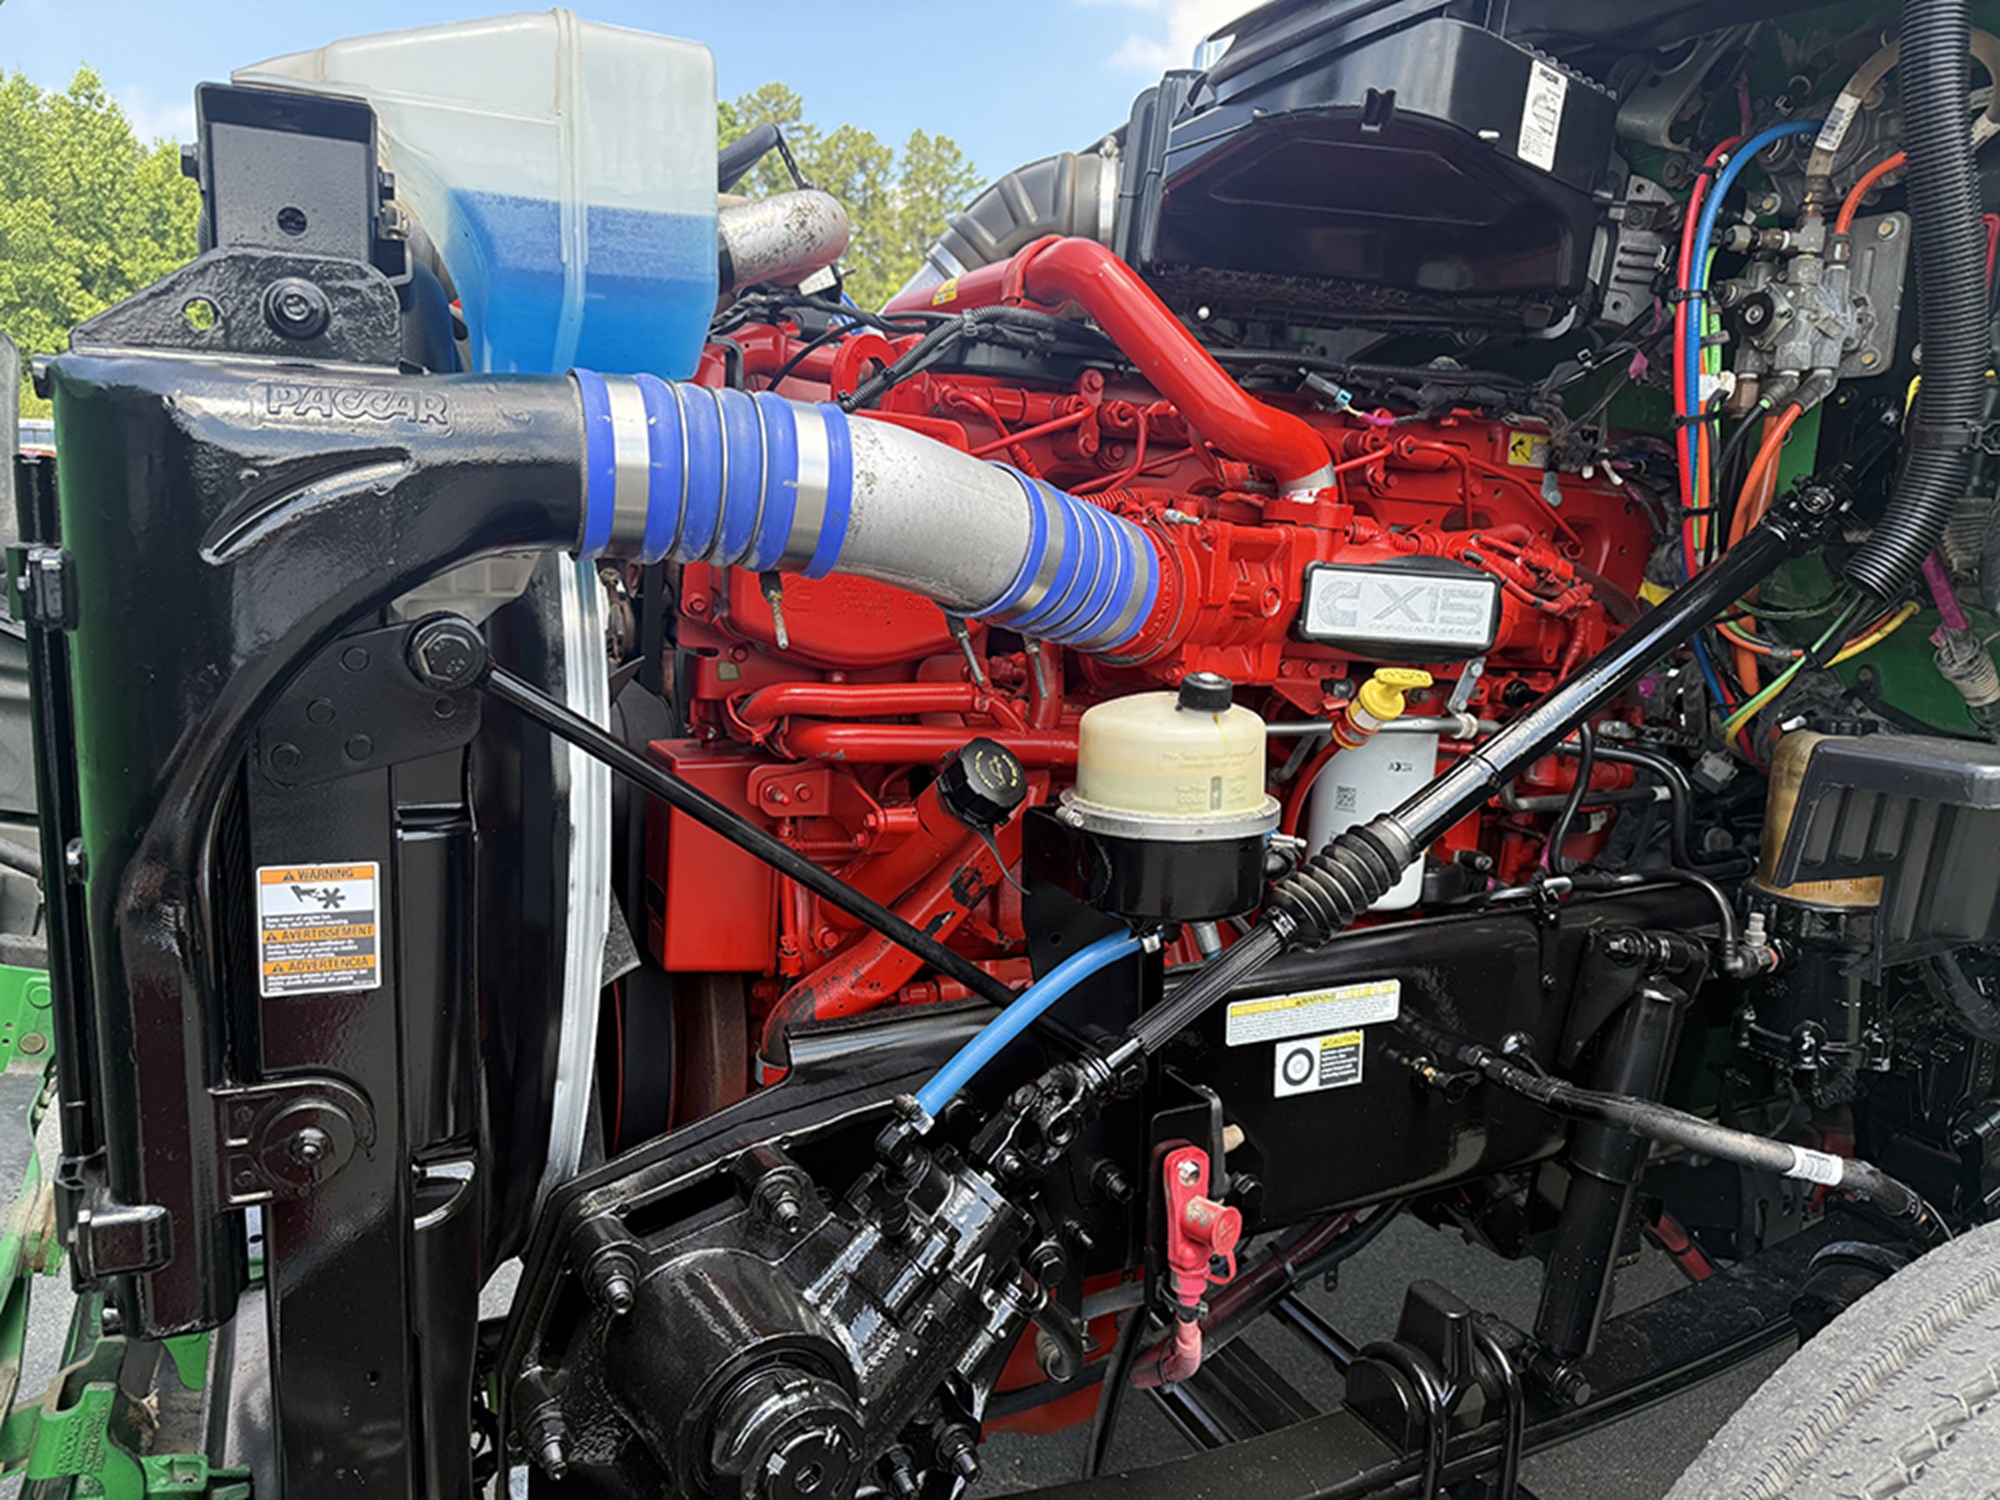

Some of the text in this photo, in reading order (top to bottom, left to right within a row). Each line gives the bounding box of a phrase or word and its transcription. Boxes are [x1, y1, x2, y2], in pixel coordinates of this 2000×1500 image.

[267, 383, 448, 424] PACCAR
[1372, 583, 1486, 624] X15
[298, 868, 354, 880] WARNING
[282, 927, 372, 940] AVERTISSEMENT
[289, 958, 368, 971] ADVERTENCIA
